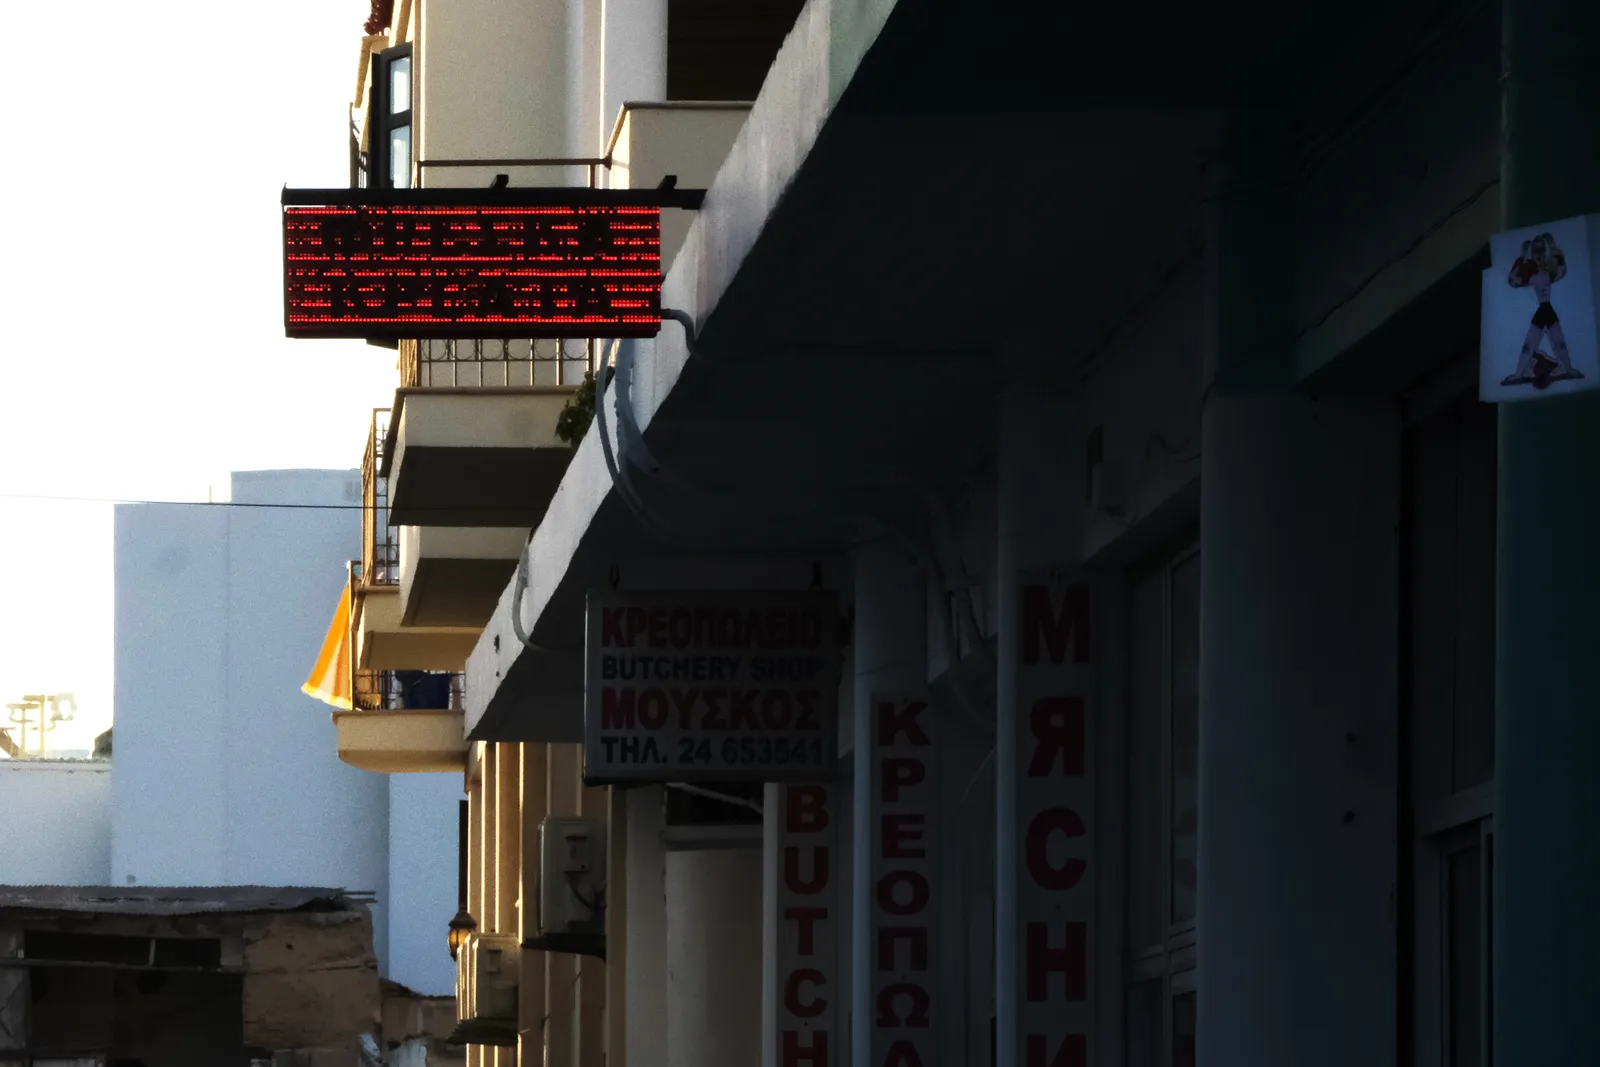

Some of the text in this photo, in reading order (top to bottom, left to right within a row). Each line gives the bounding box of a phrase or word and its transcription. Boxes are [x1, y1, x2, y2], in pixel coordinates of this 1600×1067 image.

[601, 606, 823, 649] ΚΡΕΟΠΩΛΕΙΟ
[601, 655, 821, 682] BUTCHERY SHOP
[601, 687, 822, 731] ΜΟΥΣΚΟΣ
[601, 736, 823, 766] ΤΗΛ. 24 653541
[782, 786, 829, 1067] BUTCH
